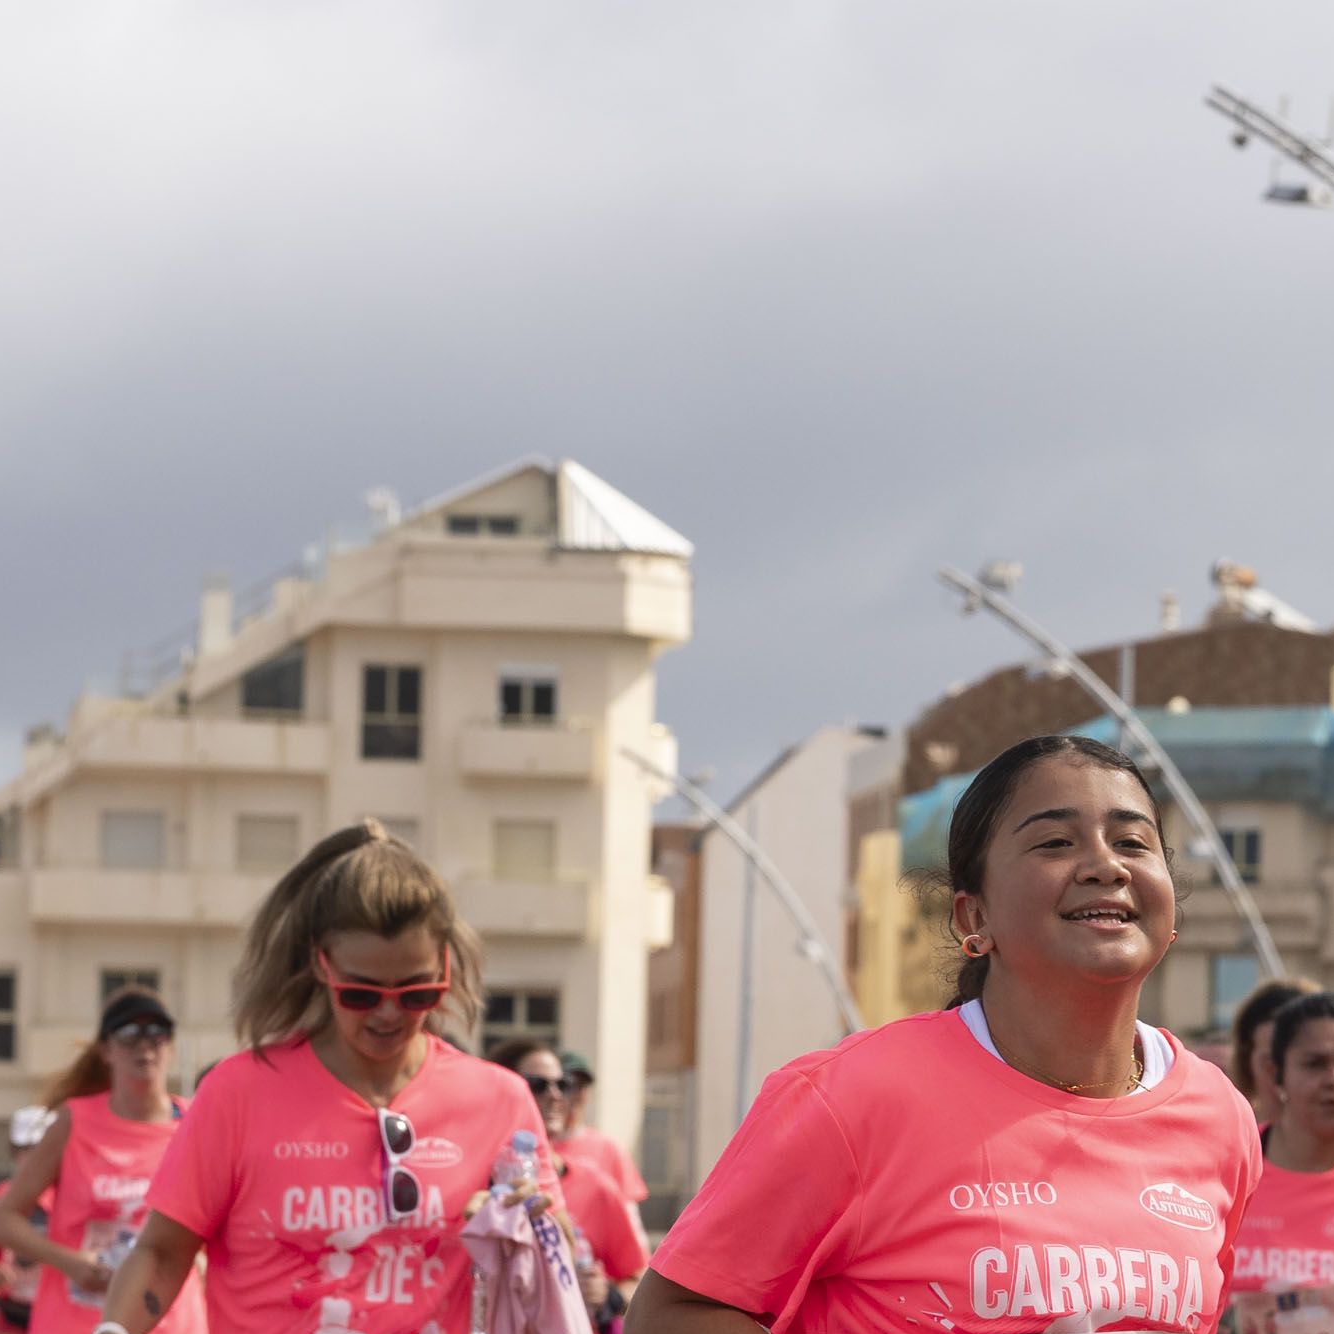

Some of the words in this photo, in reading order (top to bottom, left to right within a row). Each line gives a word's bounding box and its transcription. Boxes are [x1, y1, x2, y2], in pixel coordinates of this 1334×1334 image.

[274, 1142, 349, 1159] OYSHO
[282, 1185, 447, 1231] CARRA
[949, 1181, 1057, 1210] OYSHO
[969, 1244, 1204, 1330] CARRERA
